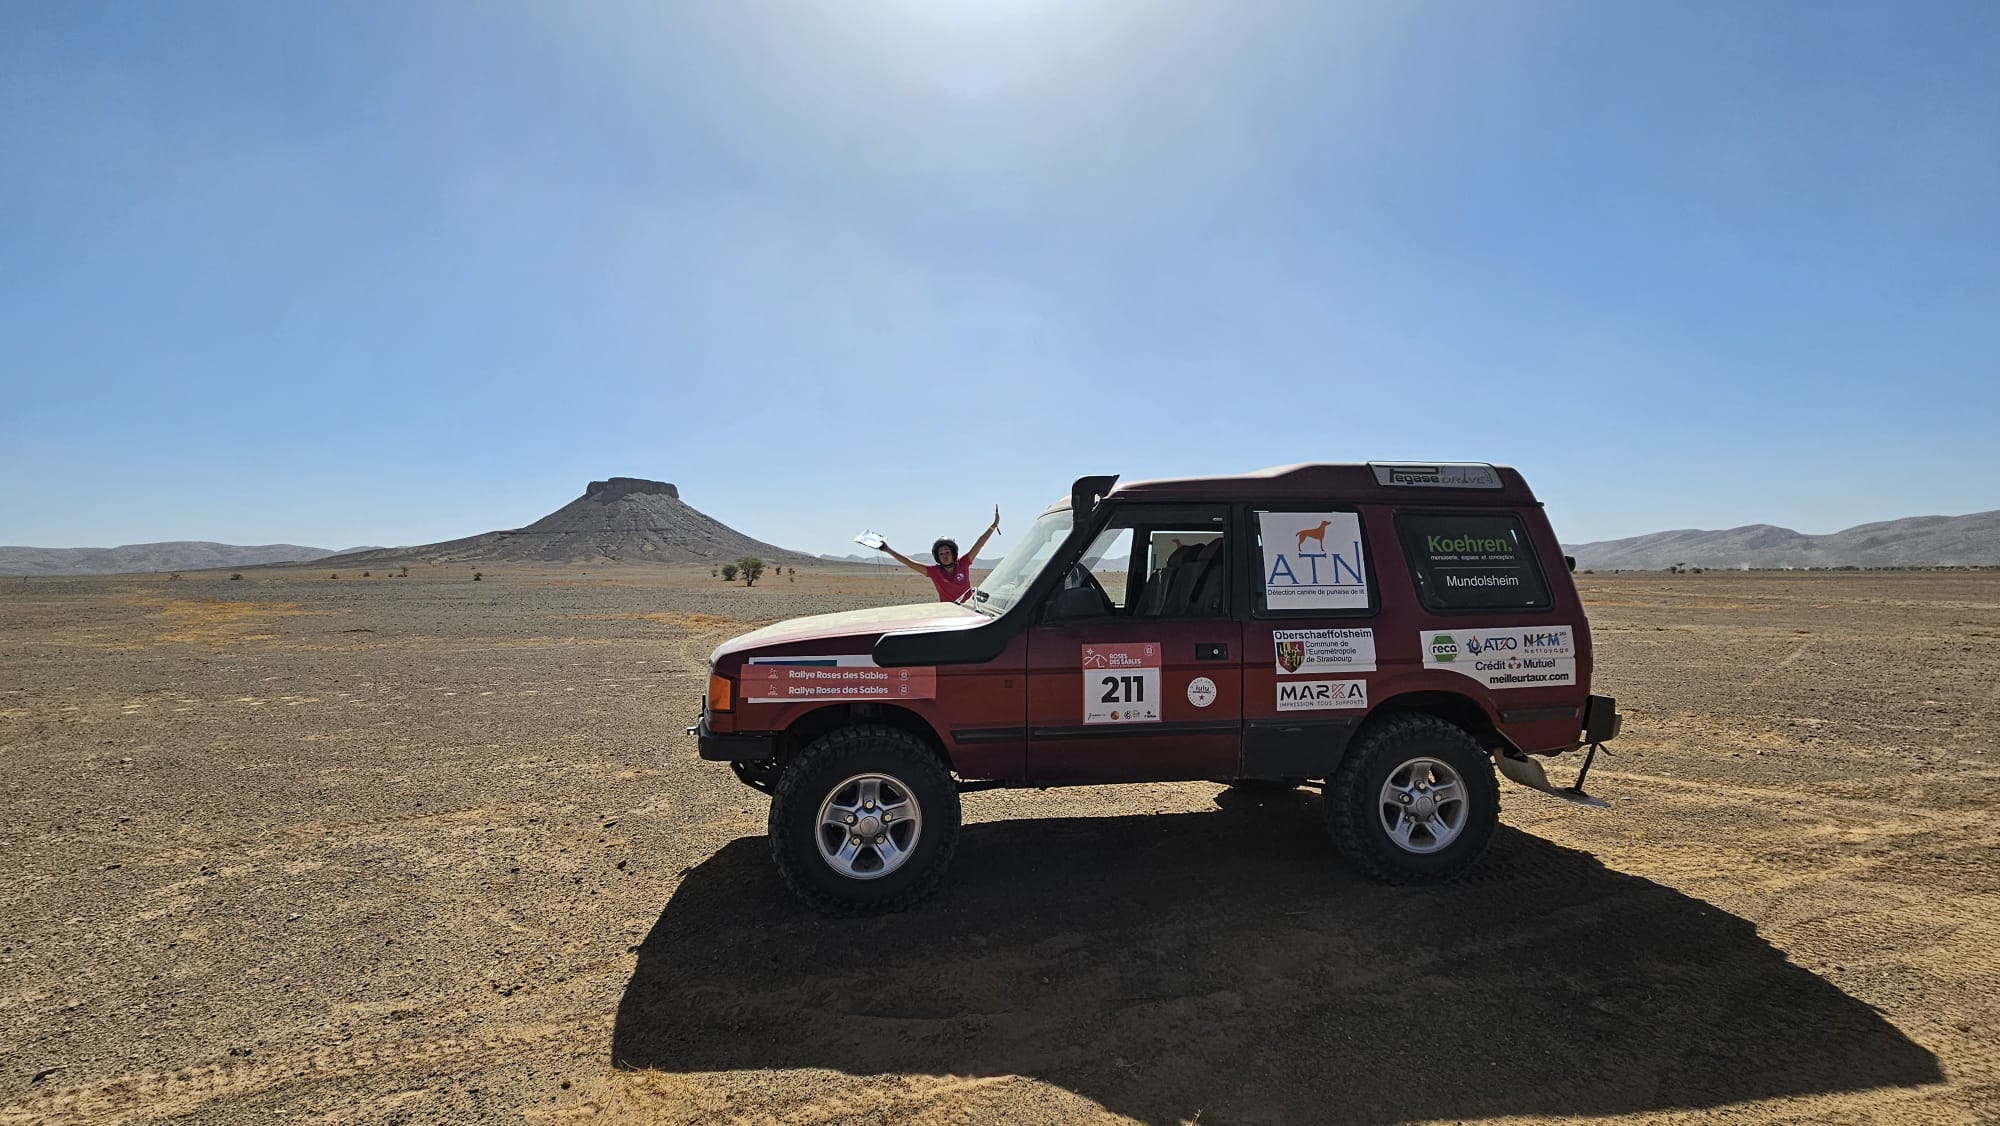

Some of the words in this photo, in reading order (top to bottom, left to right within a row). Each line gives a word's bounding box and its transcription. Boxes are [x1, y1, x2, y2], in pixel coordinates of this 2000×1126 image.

[1389, 466, 1440, 484] Pegase
[1428, 534, 1513, 552] Koehren.
[1267, 541, 1364, 585] ATN
[1446, 574, 1519, 587] Mundolsheim
[1326, 589, 1349, 597] punaise
[1274, 630, 1372, 640] Oberschaeffolsheim
[1523, 632, 1560, 647] NKM
[1432, 645, 1458, 654] reca
[1316, 655, 1352, 663] Strasbourg
[1475, 661, 1506, 671] Crédit
[1523, 658, 1556, 669] Mutuel
[789, 670, 816, 681] Rallye
[816, 671, 841, 680] Roses
[842, 671, 858, 680] des
[859, 671, 889, 680] Sables
[1489, 673, 1569, 684] meilleurtaux.com
[788, 685, 815, 696] Rallye
[816, 686, 841, 695] Roses
[842, 685, 858, 694] des
[859, 686, 889, 694] Sables
[1101, 676, 1144, 703] 211
[1280, 684, 1364, 701] MARKA
